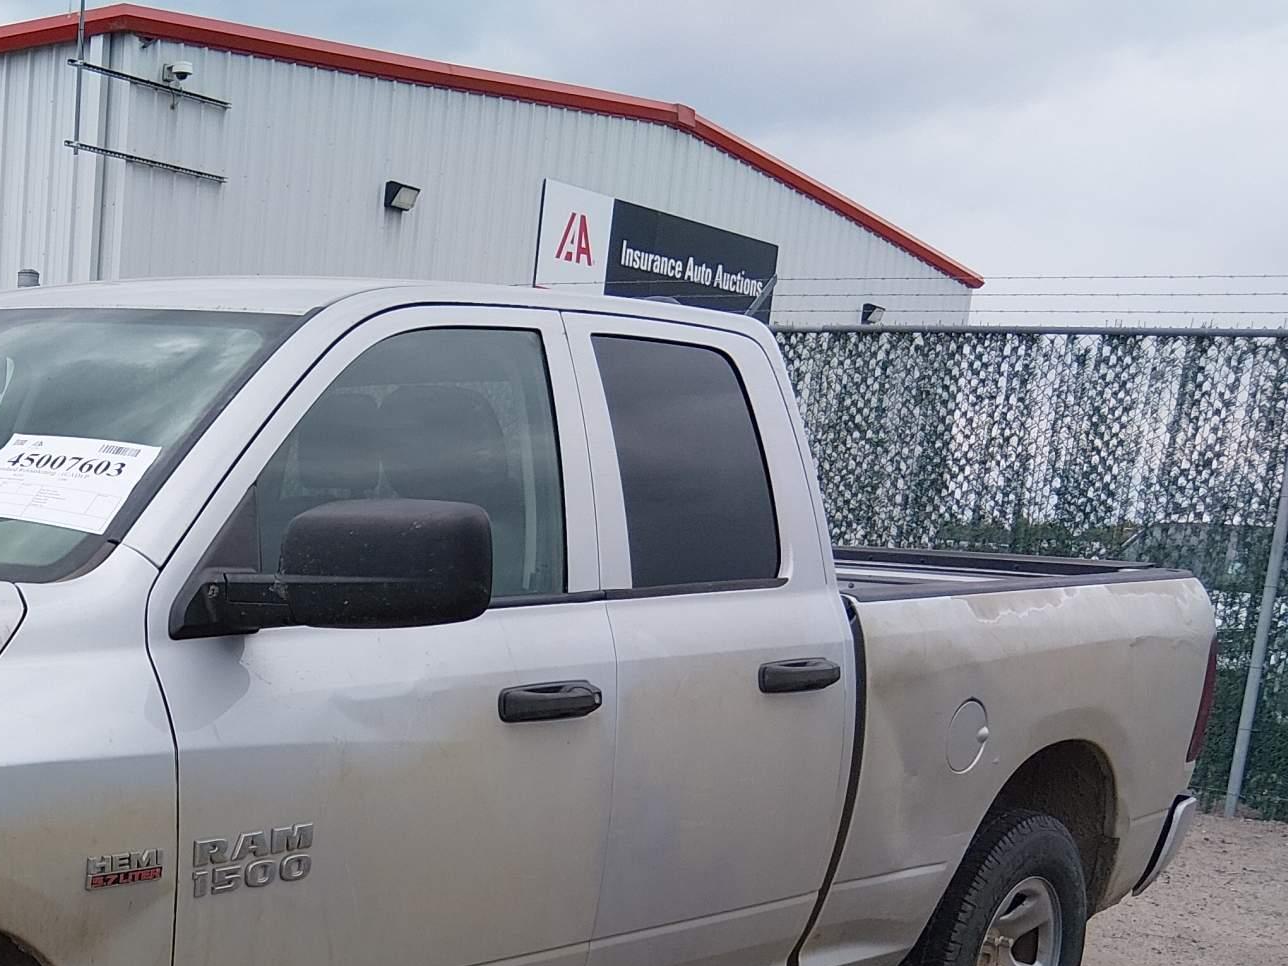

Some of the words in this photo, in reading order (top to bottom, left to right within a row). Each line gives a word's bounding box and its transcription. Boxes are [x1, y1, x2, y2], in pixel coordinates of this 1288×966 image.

[620, 239, 683, 279] Insurance
[684, 256, 713, 286] Auto
[713, 263, 764, 298] Auctions
[7, 452, 126, 477] 45007603
[193, 823, 313, 868] RAM
[192, 853, 312, 899] 1500
